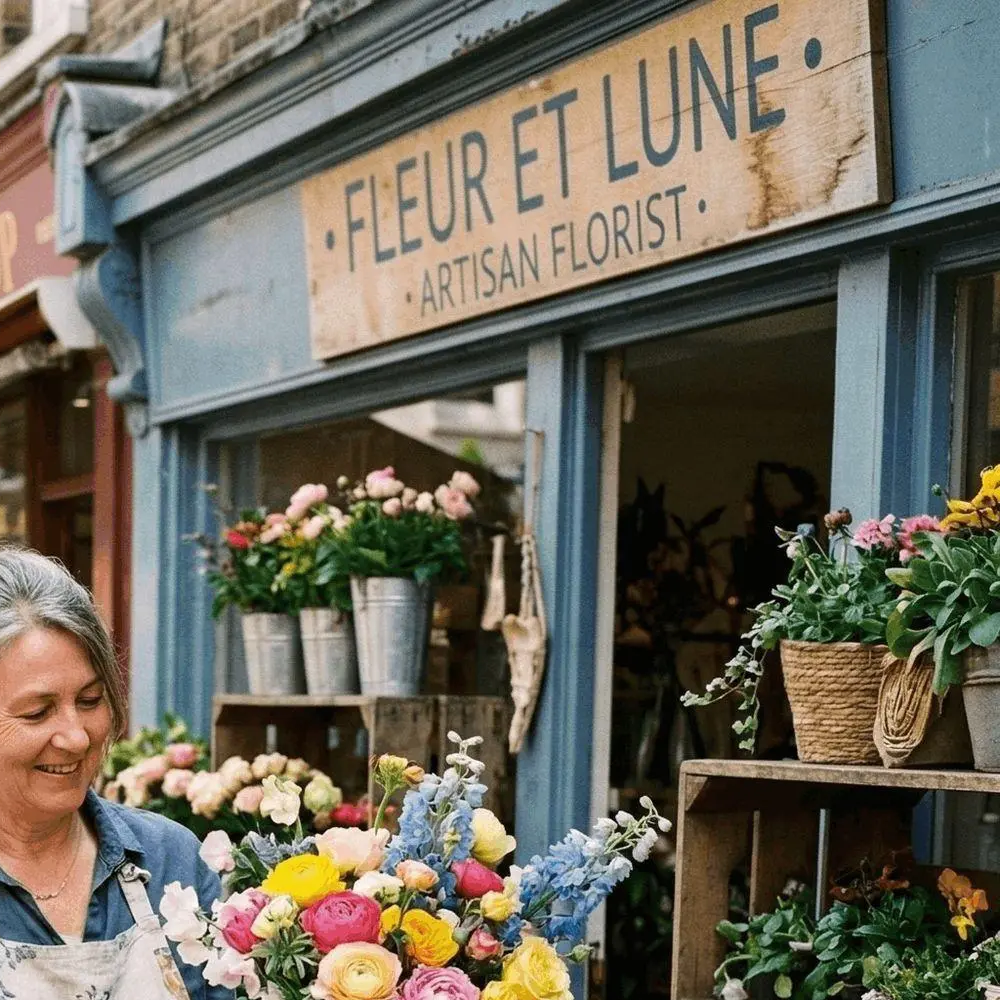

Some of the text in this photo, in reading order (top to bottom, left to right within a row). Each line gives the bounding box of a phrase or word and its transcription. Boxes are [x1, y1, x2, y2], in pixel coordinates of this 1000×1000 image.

[345, 4, 786, 272] FLEUR ET LUNE
[420, 185, 687, 317] ARTISAN FLORIST
